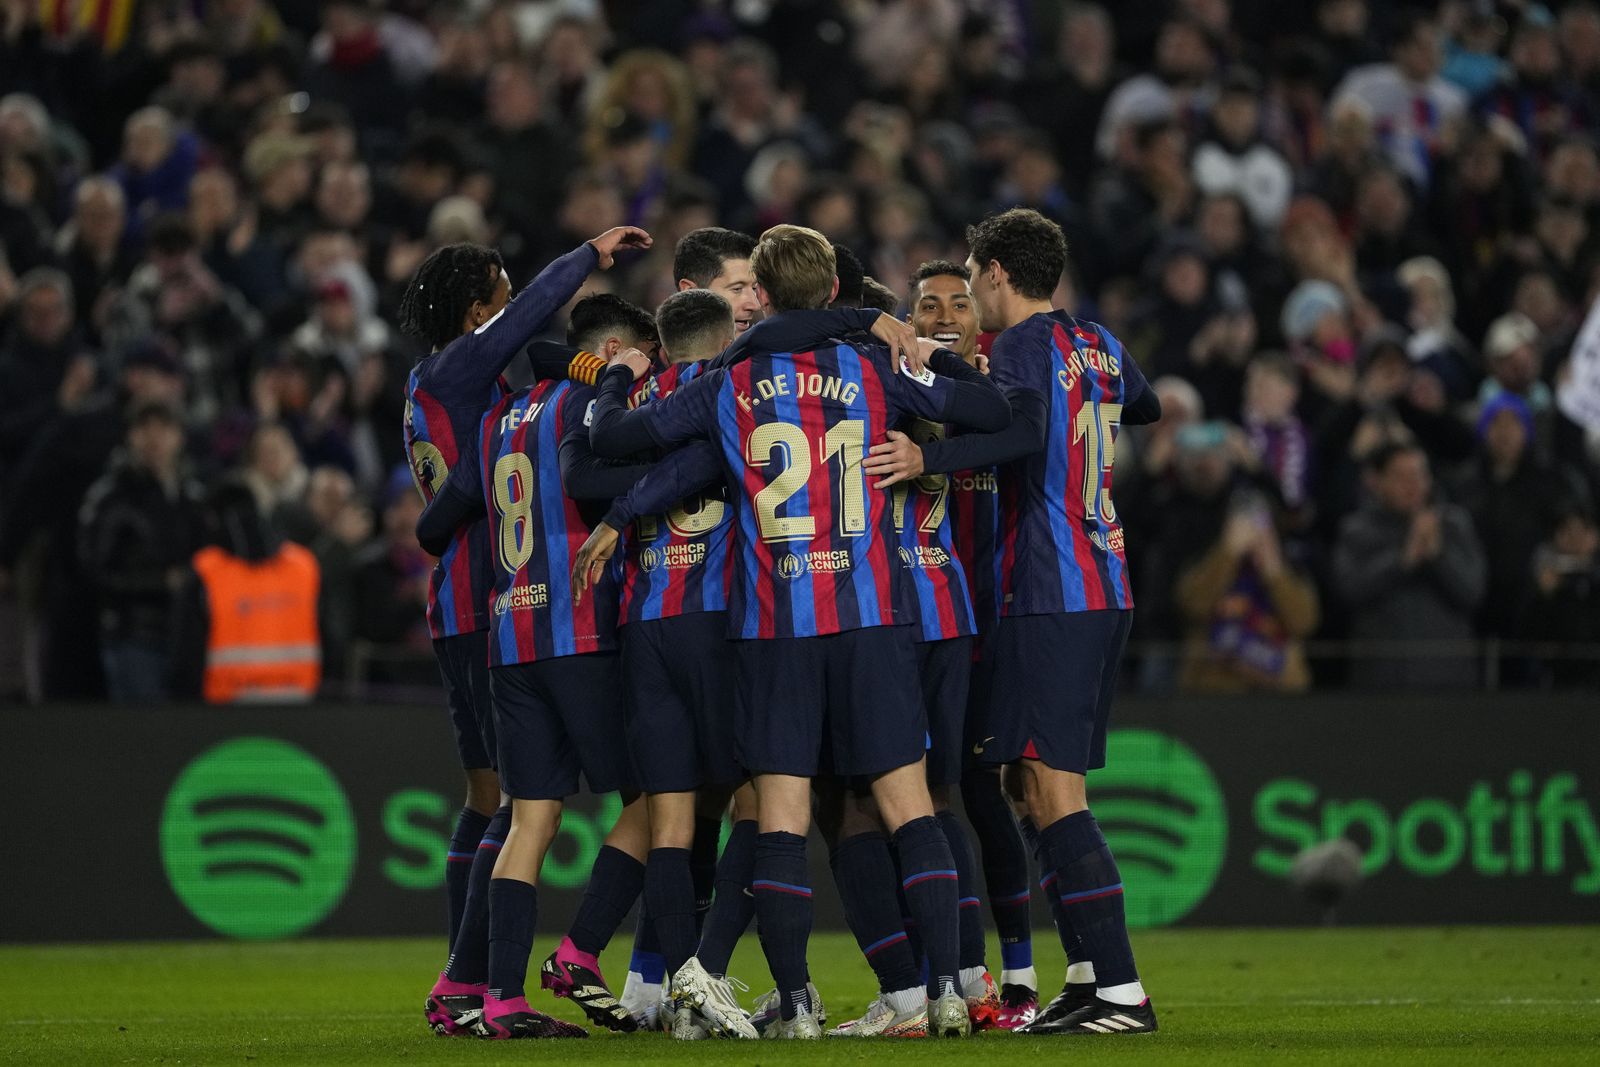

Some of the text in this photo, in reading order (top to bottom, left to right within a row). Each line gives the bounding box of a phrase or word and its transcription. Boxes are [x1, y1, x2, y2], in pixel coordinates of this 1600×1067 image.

[736, 372, 860, 413] F. DE JONG
[1072, 400, 1123, 523] 15
[746, 419, 866, 544] 21
[493, 452, 534, 575] 8
[662, 543, 706, 556] UNHCR
[804, 550, 849, 562] UNHCR
[663, 552, 705, 566] ACNUR
[806, 558, 850, 571] ACNUR
[509, 593, 548, 607] ACNUR
